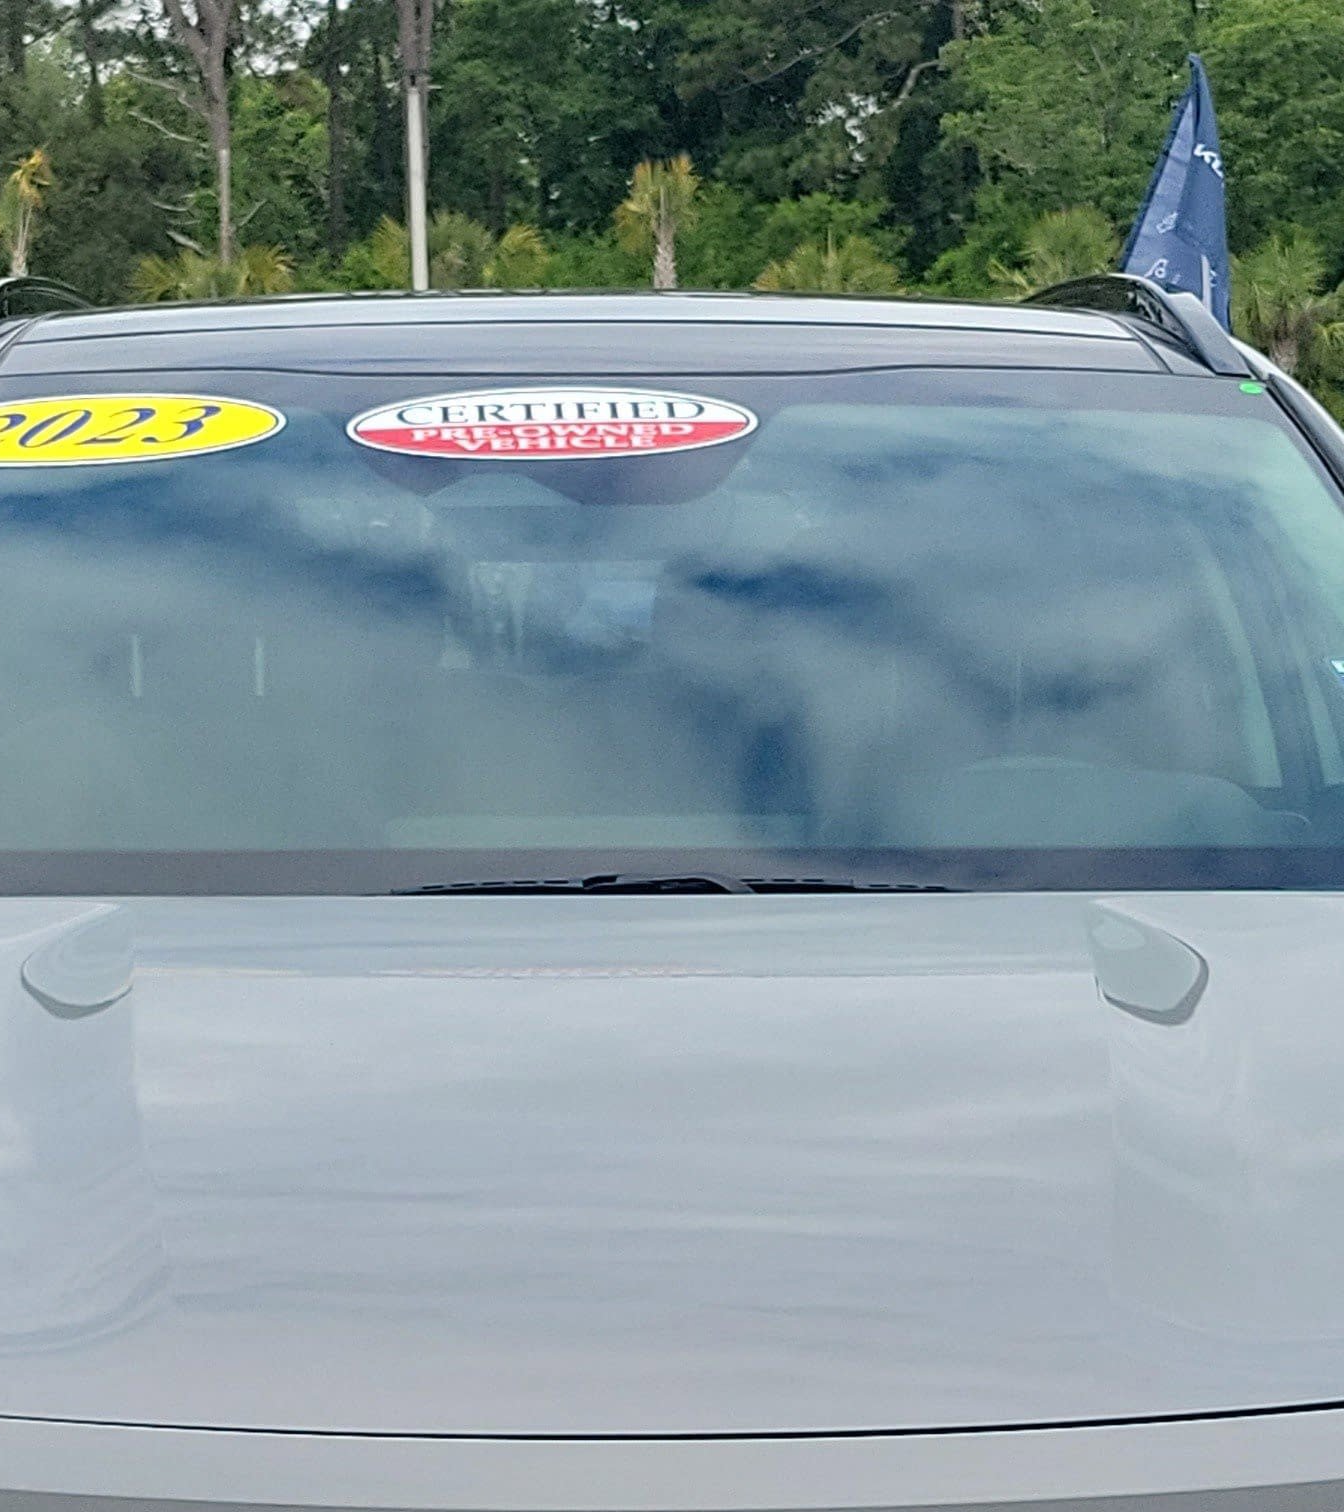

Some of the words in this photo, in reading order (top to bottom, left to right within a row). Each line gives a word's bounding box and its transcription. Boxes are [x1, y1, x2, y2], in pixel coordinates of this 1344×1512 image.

[397, 400, 705, 425] CERTIFIED
[411, 422, 694, 442] PRE-OWNED
[457, 435, 655, 451] VEHICLE
